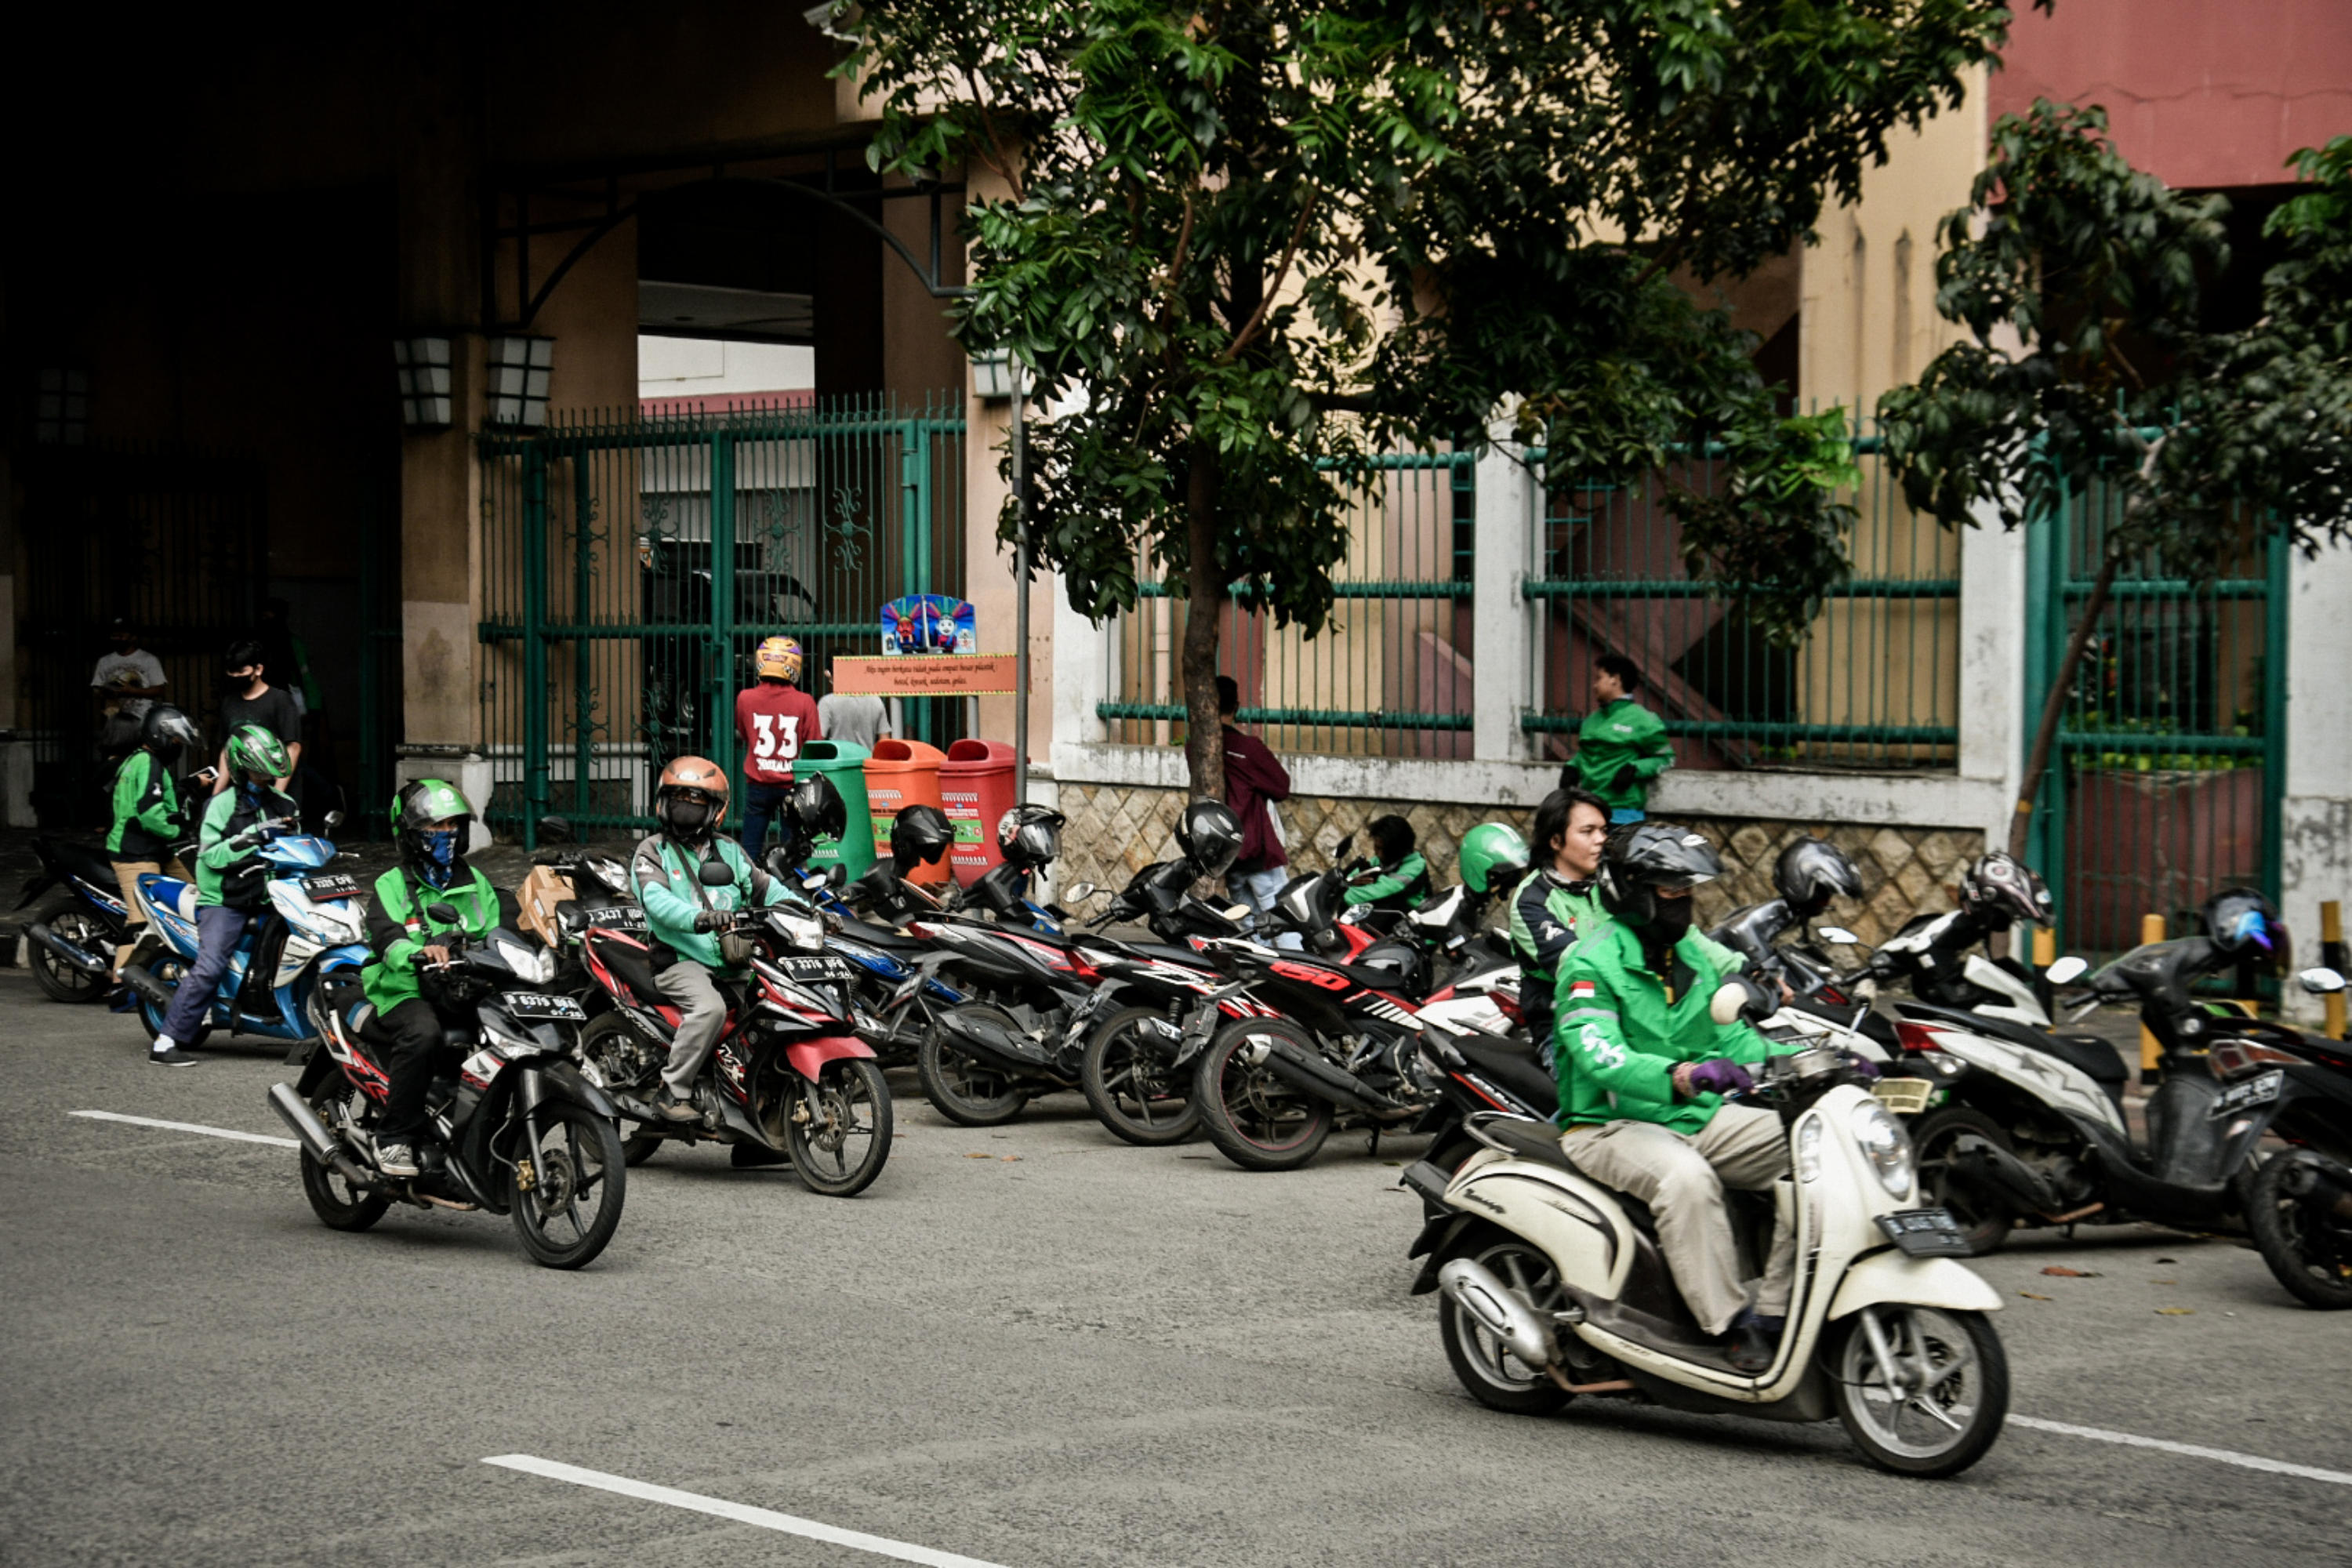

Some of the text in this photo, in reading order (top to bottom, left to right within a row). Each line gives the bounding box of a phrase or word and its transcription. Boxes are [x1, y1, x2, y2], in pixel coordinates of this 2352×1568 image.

[753, 712, 799, 759] 33
[1268, 960, 1351, 992] 150
[506, 993, 517, 1004] B
